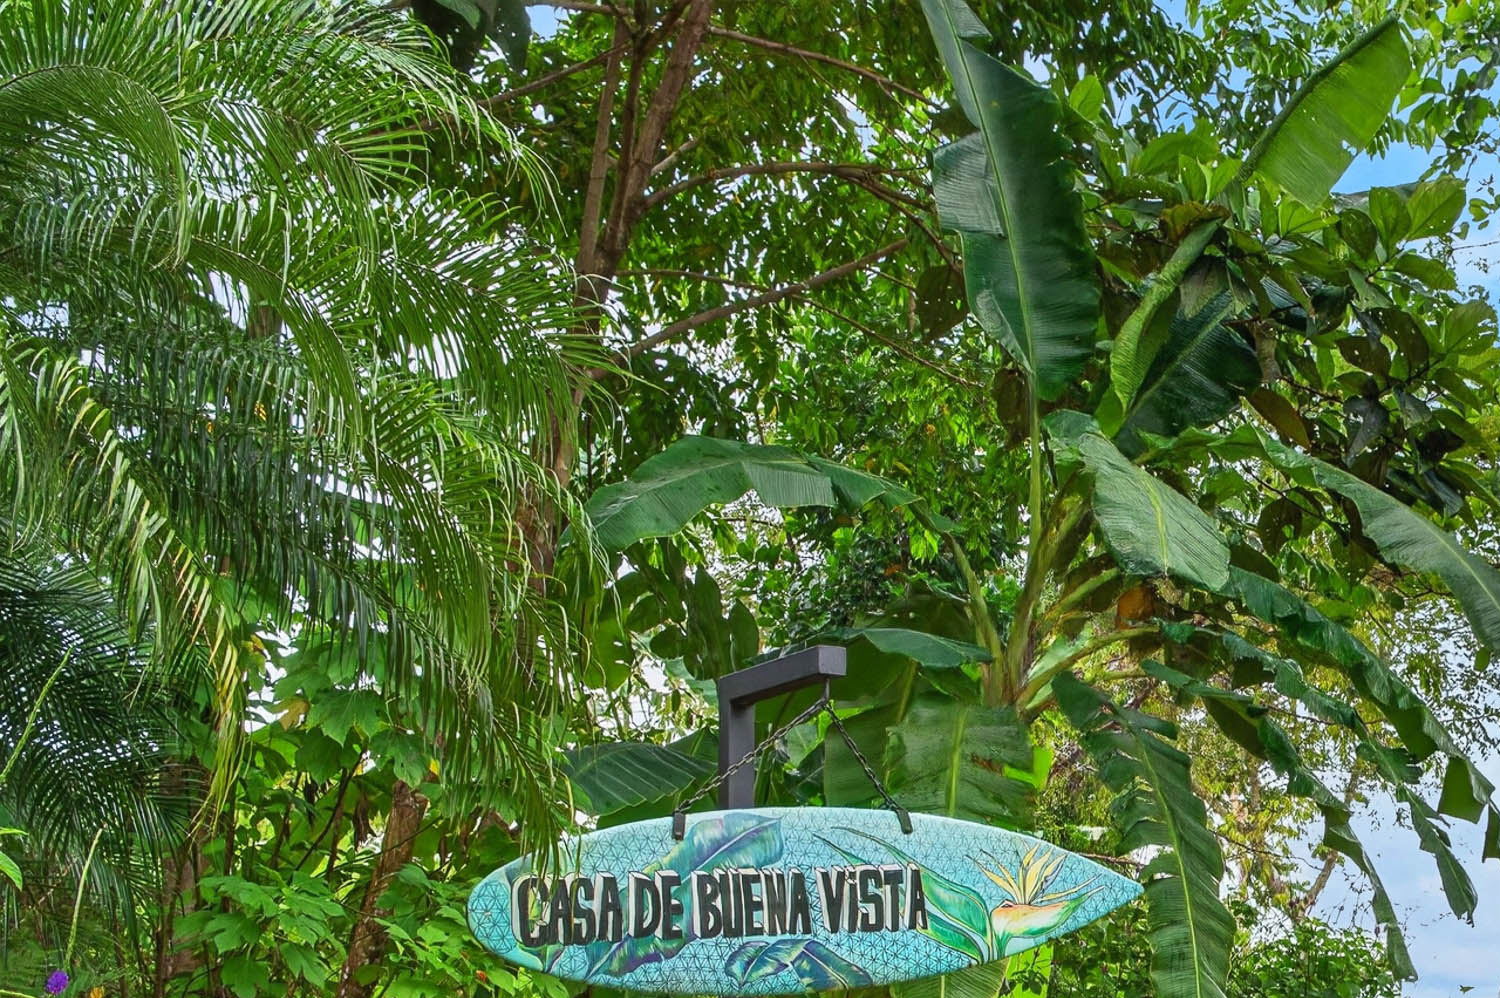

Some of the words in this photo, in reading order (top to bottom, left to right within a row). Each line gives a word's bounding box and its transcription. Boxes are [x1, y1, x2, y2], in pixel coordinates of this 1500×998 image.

[512, 872, 625, 947] CASA
[629, 871, 684, 939] DE
[691, 866, 812, 939] BUENA
